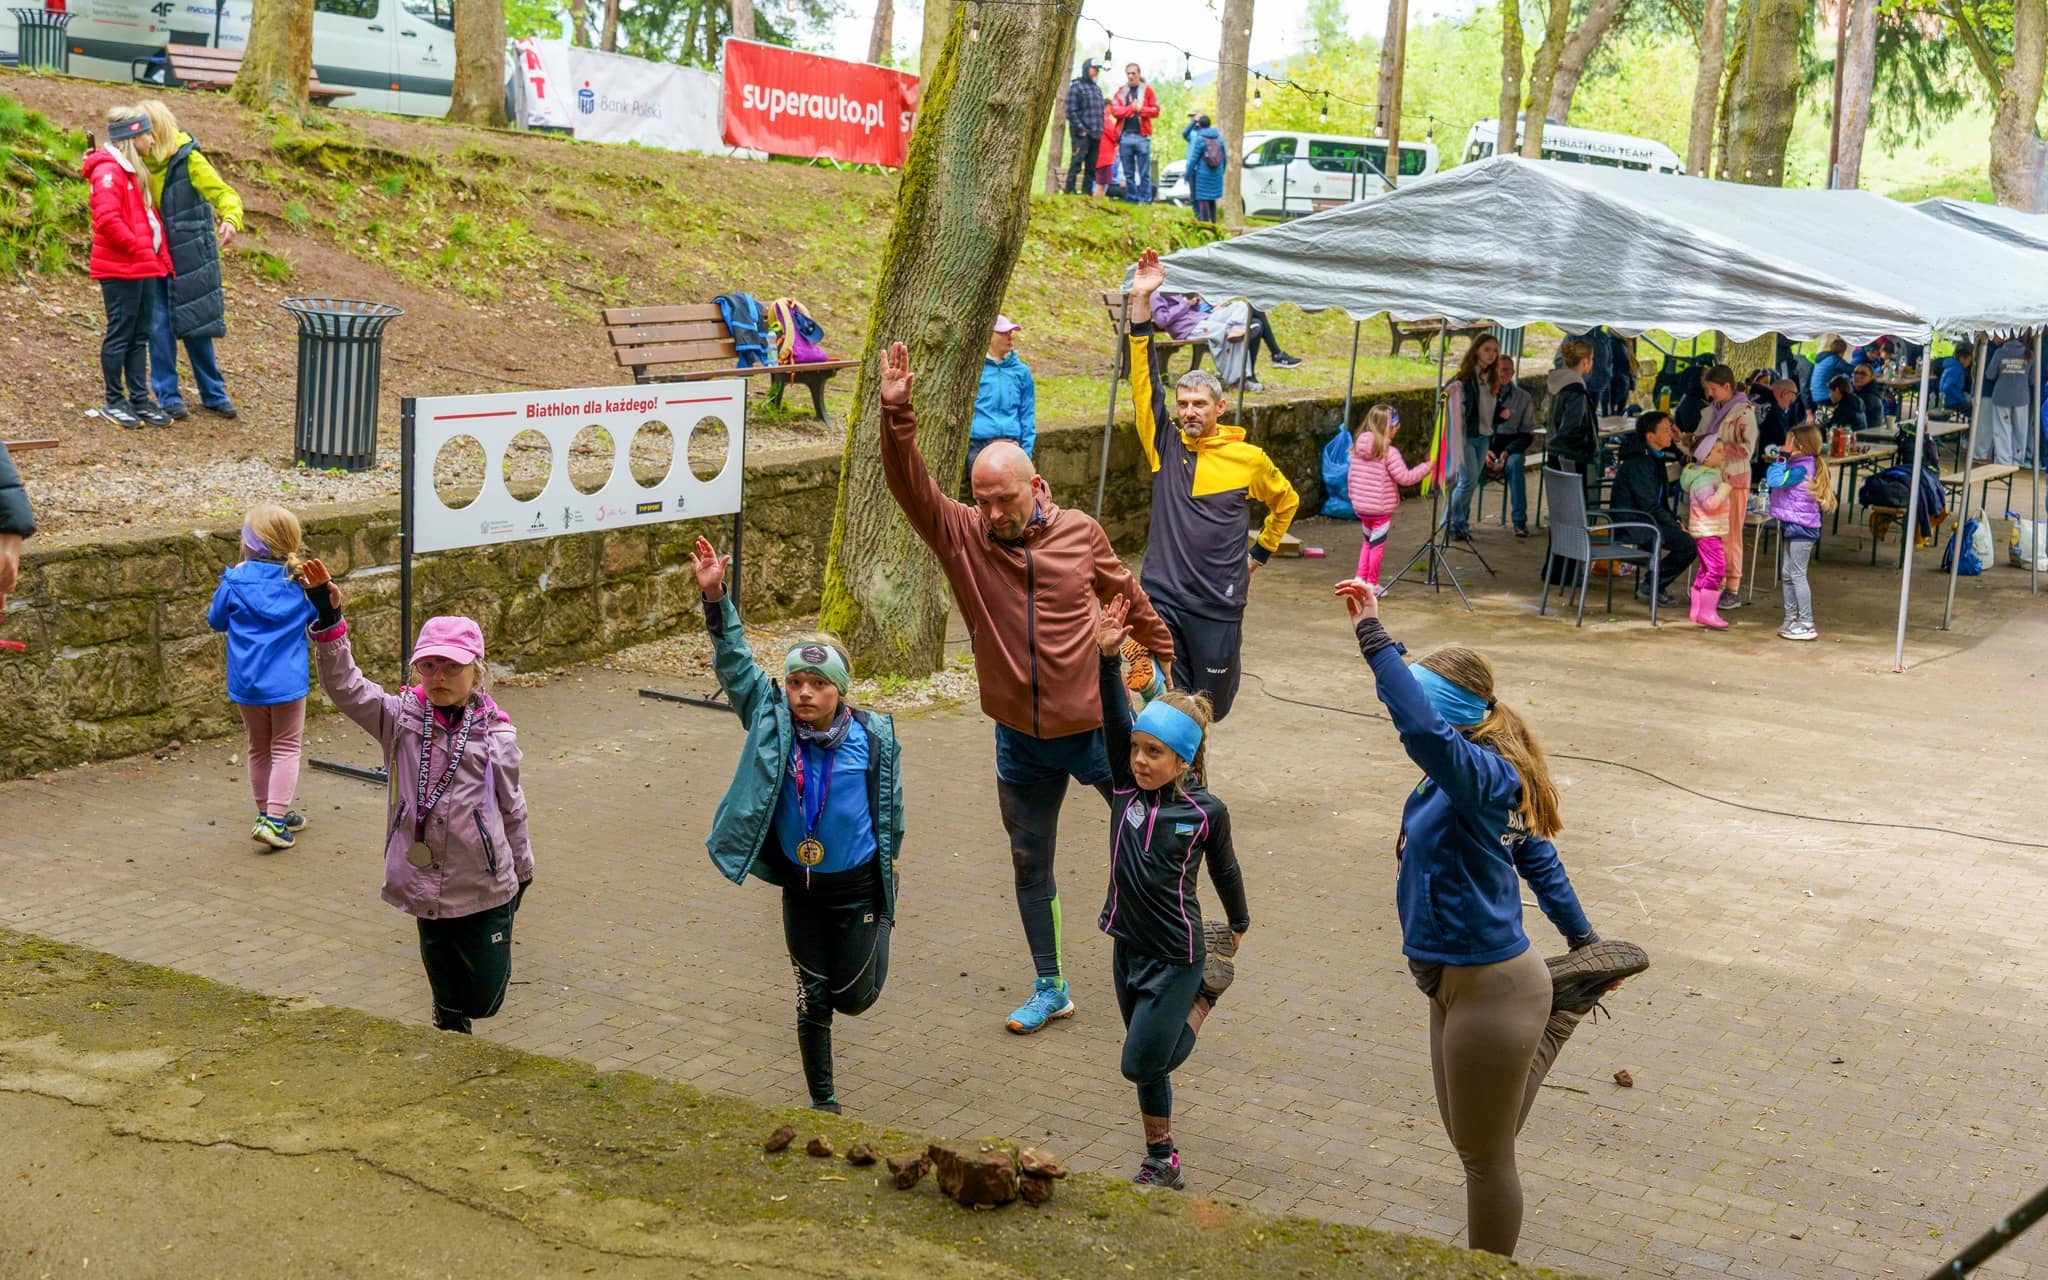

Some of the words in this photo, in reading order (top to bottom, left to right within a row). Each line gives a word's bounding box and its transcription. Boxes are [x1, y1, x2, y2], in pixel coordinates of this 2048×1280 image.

[151, 1, 175, 17] 4F
[600, 95, 628, 113] Bank
[631, 101, 662, 119] Polski
[742, 84, 885, 135] superauto.pl
[1559, 138, 1616, 154] BIATHLON
[1619, 147, 1650, 159] TEAM
[526, 402, 580, 418] Biathlon
[583, 400, 602, 414] dla
[605, 396, 658, 414] każdego!
[422, 741, 432, 759] DLA
[425, 770, 453, 810] BIATHLON
[448, 752, 462, 771] DLA
